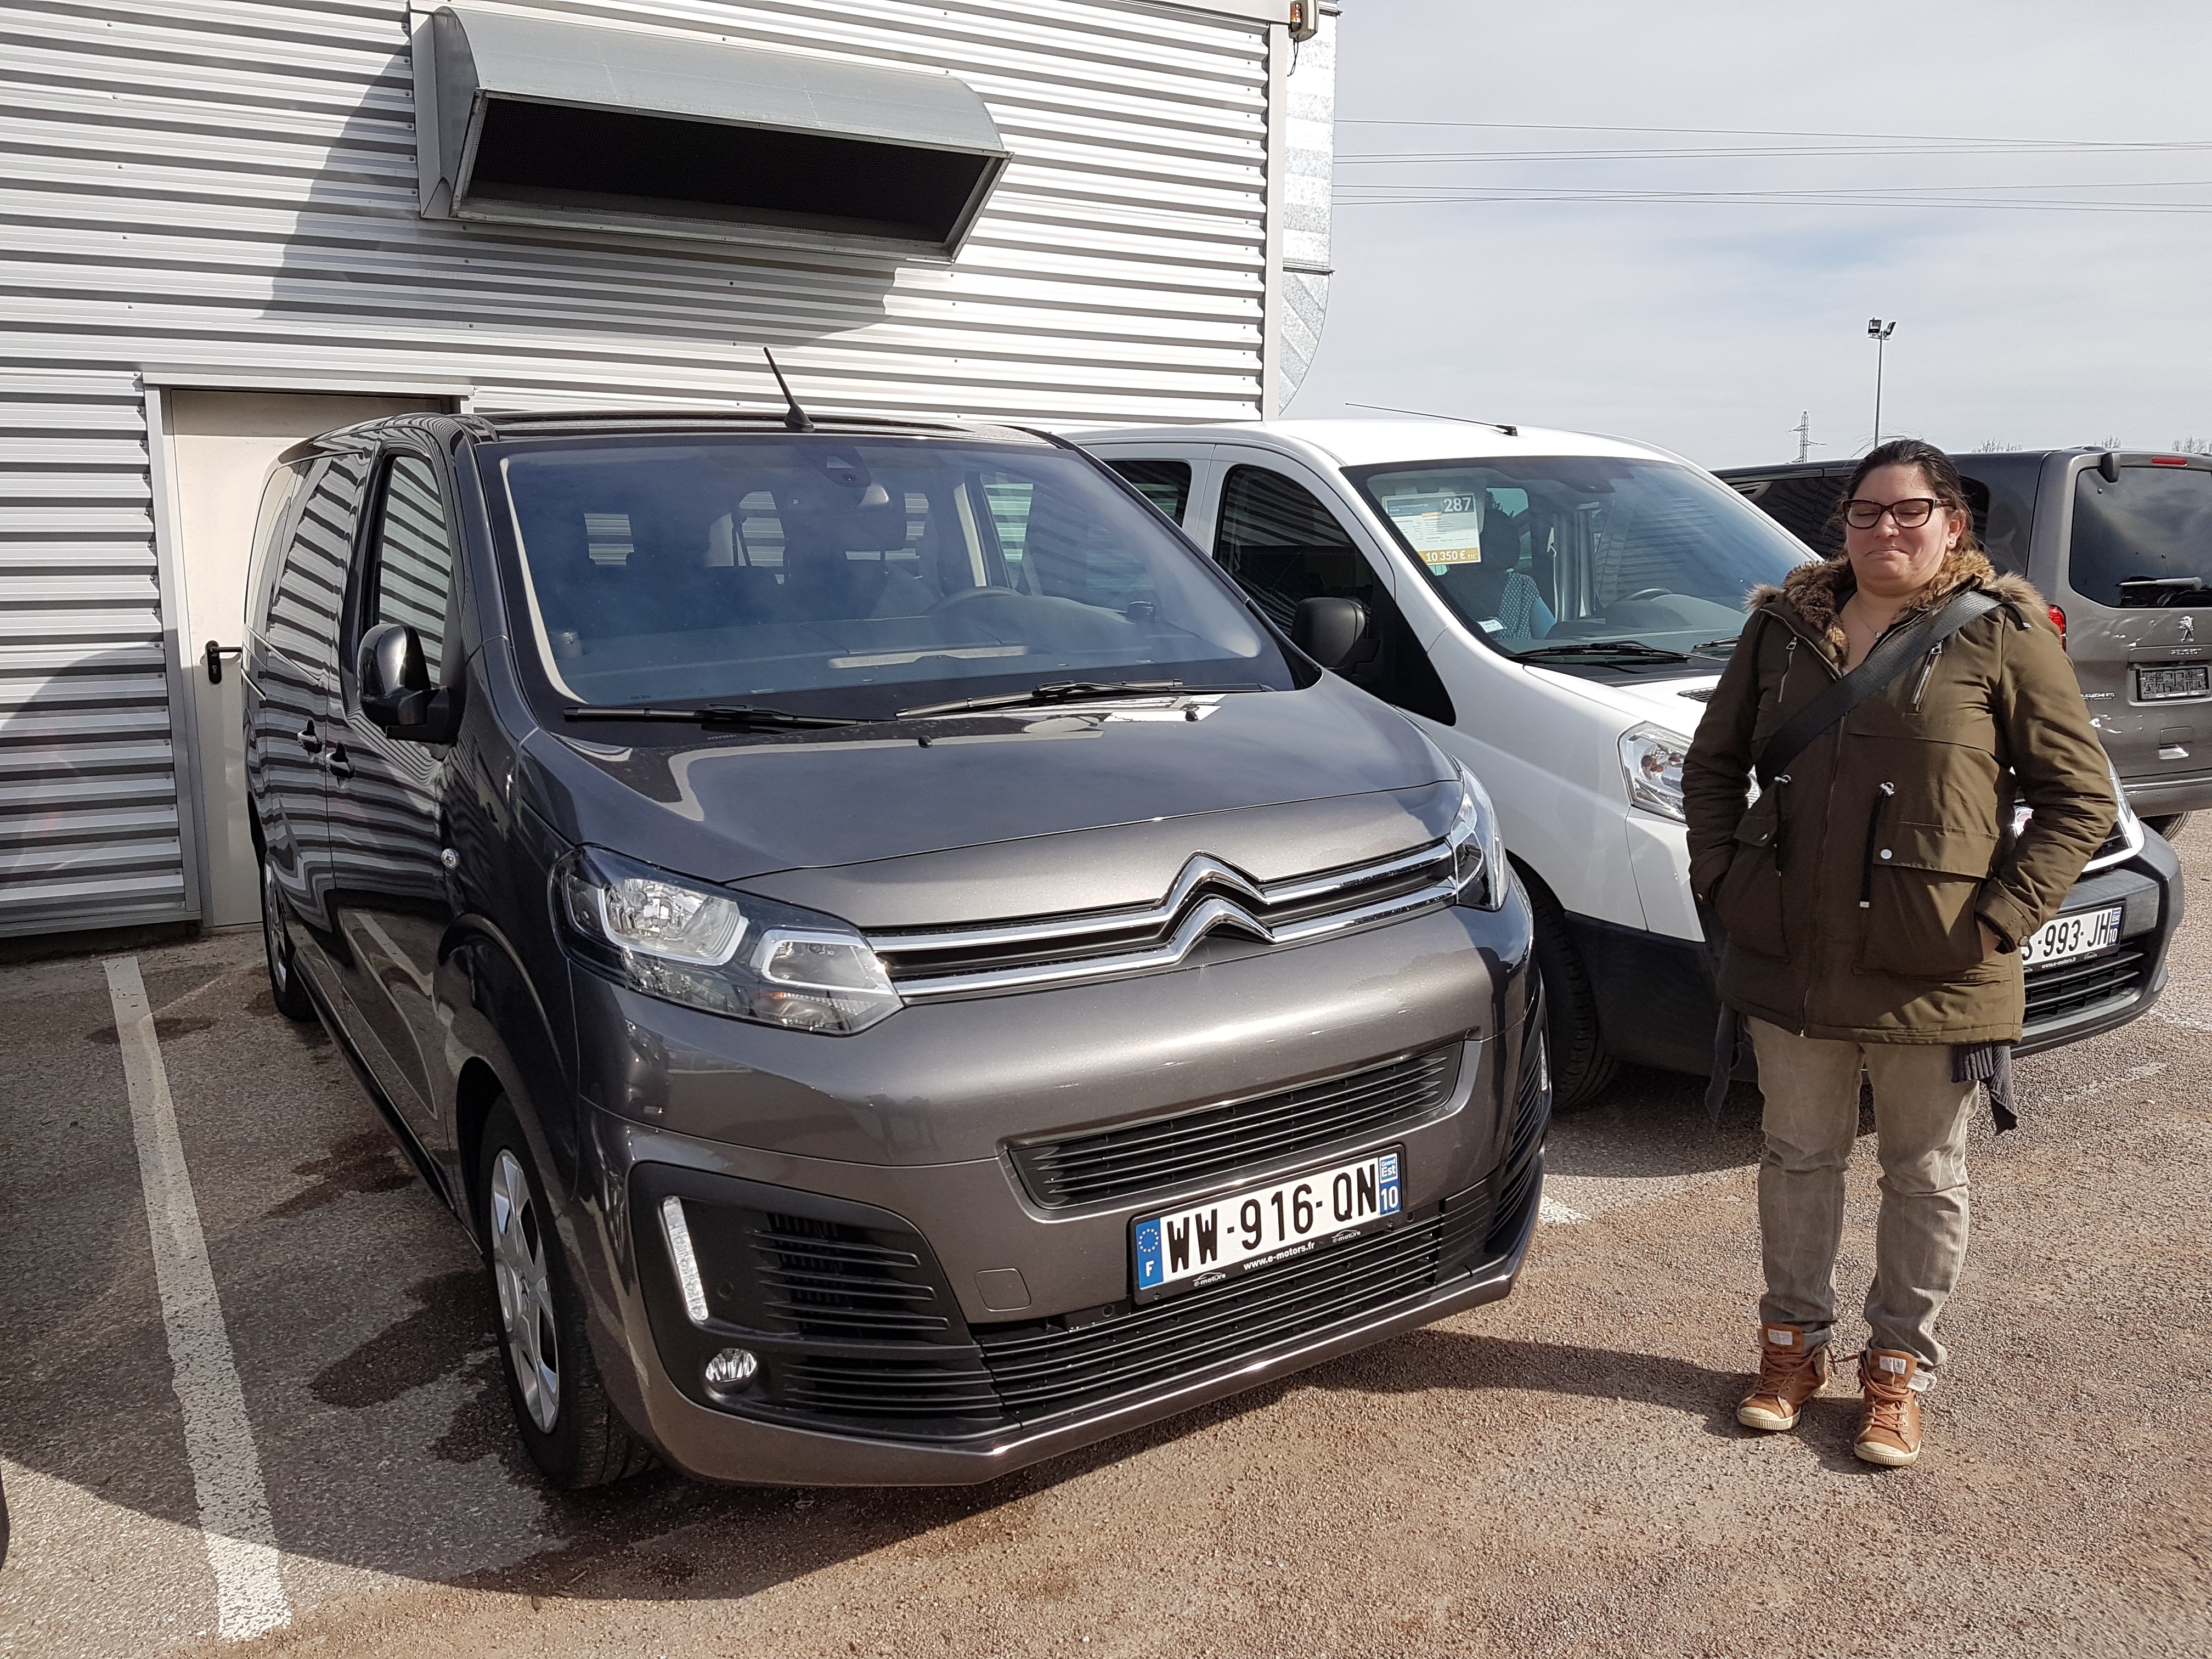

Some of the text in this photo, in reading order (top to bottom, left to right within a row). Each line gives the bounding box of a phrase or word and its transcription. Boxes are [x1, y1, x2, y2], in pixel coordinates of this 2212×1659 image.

[1444, 498, 1471, 511] 287
[1426, 552, 1438, 561] 10
[1440, 551, 1458, 561] 350
[1460, 550, 1466, 559] €
[2109, 928, 2118, 943] 10
[1381, 1158, 1396, 1166] Grand
[1382, 1164, 1397, 1178] Est
[1381, 1186, 1398, 1210] 10
[1243, 1242, 1316, 1271] www.e-motors.fr
[1146, 1261, 1154, 1277] F
